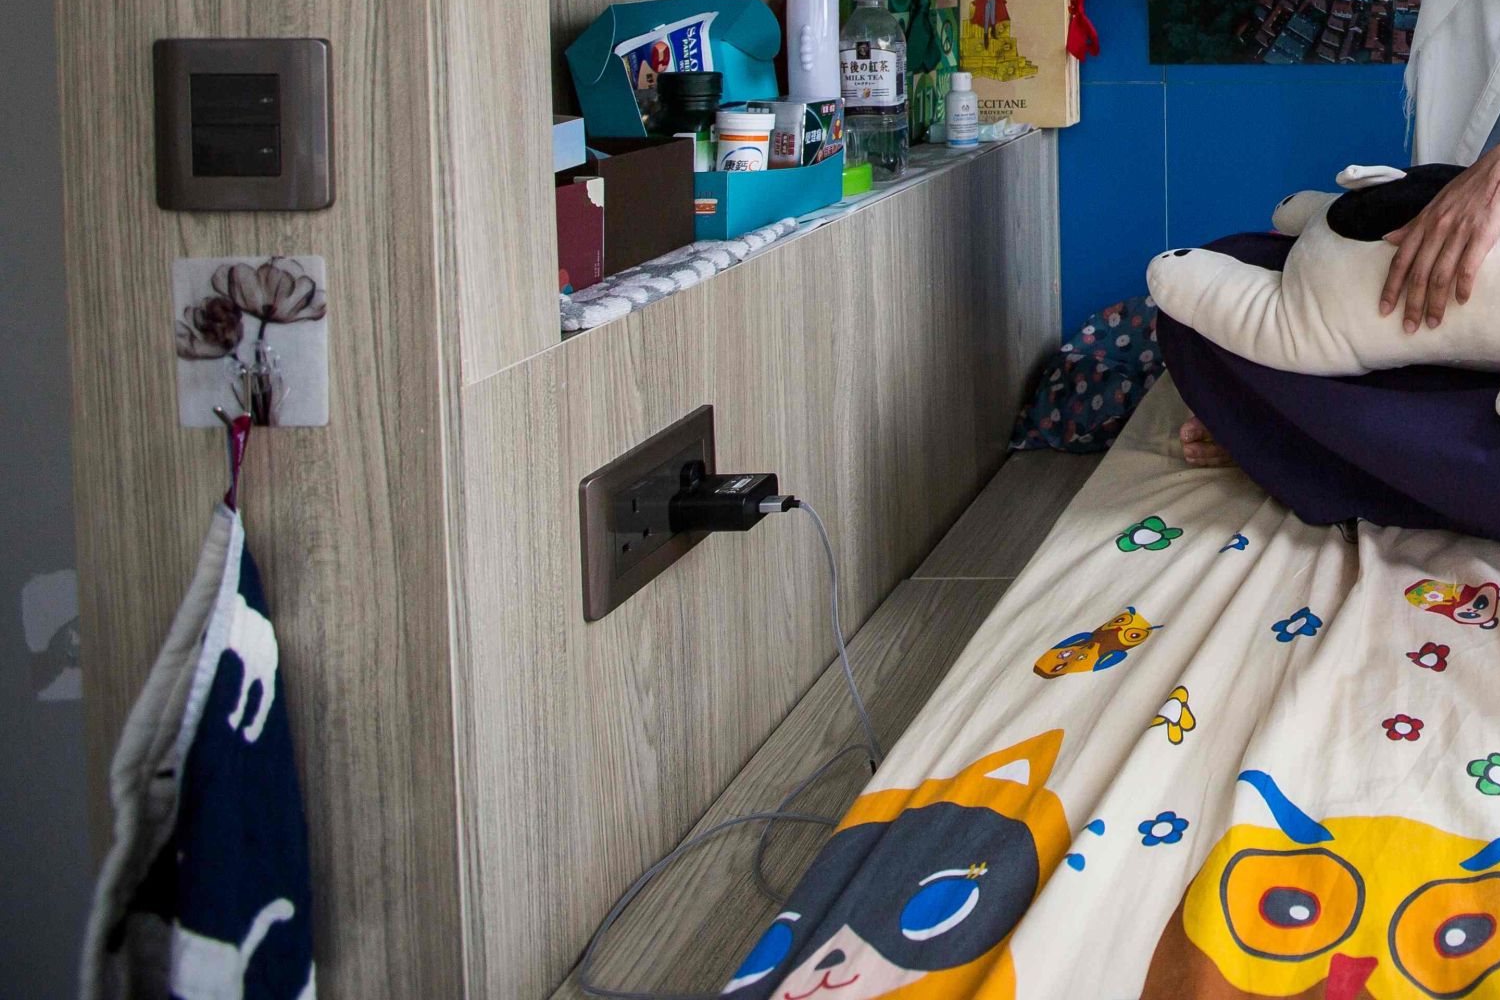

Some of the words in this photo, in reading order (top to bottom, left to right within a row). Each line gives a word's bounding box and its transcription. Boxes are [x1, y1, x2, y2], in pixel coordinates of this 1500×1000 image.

[841, 60, 888, 73] 午後の紅茶
